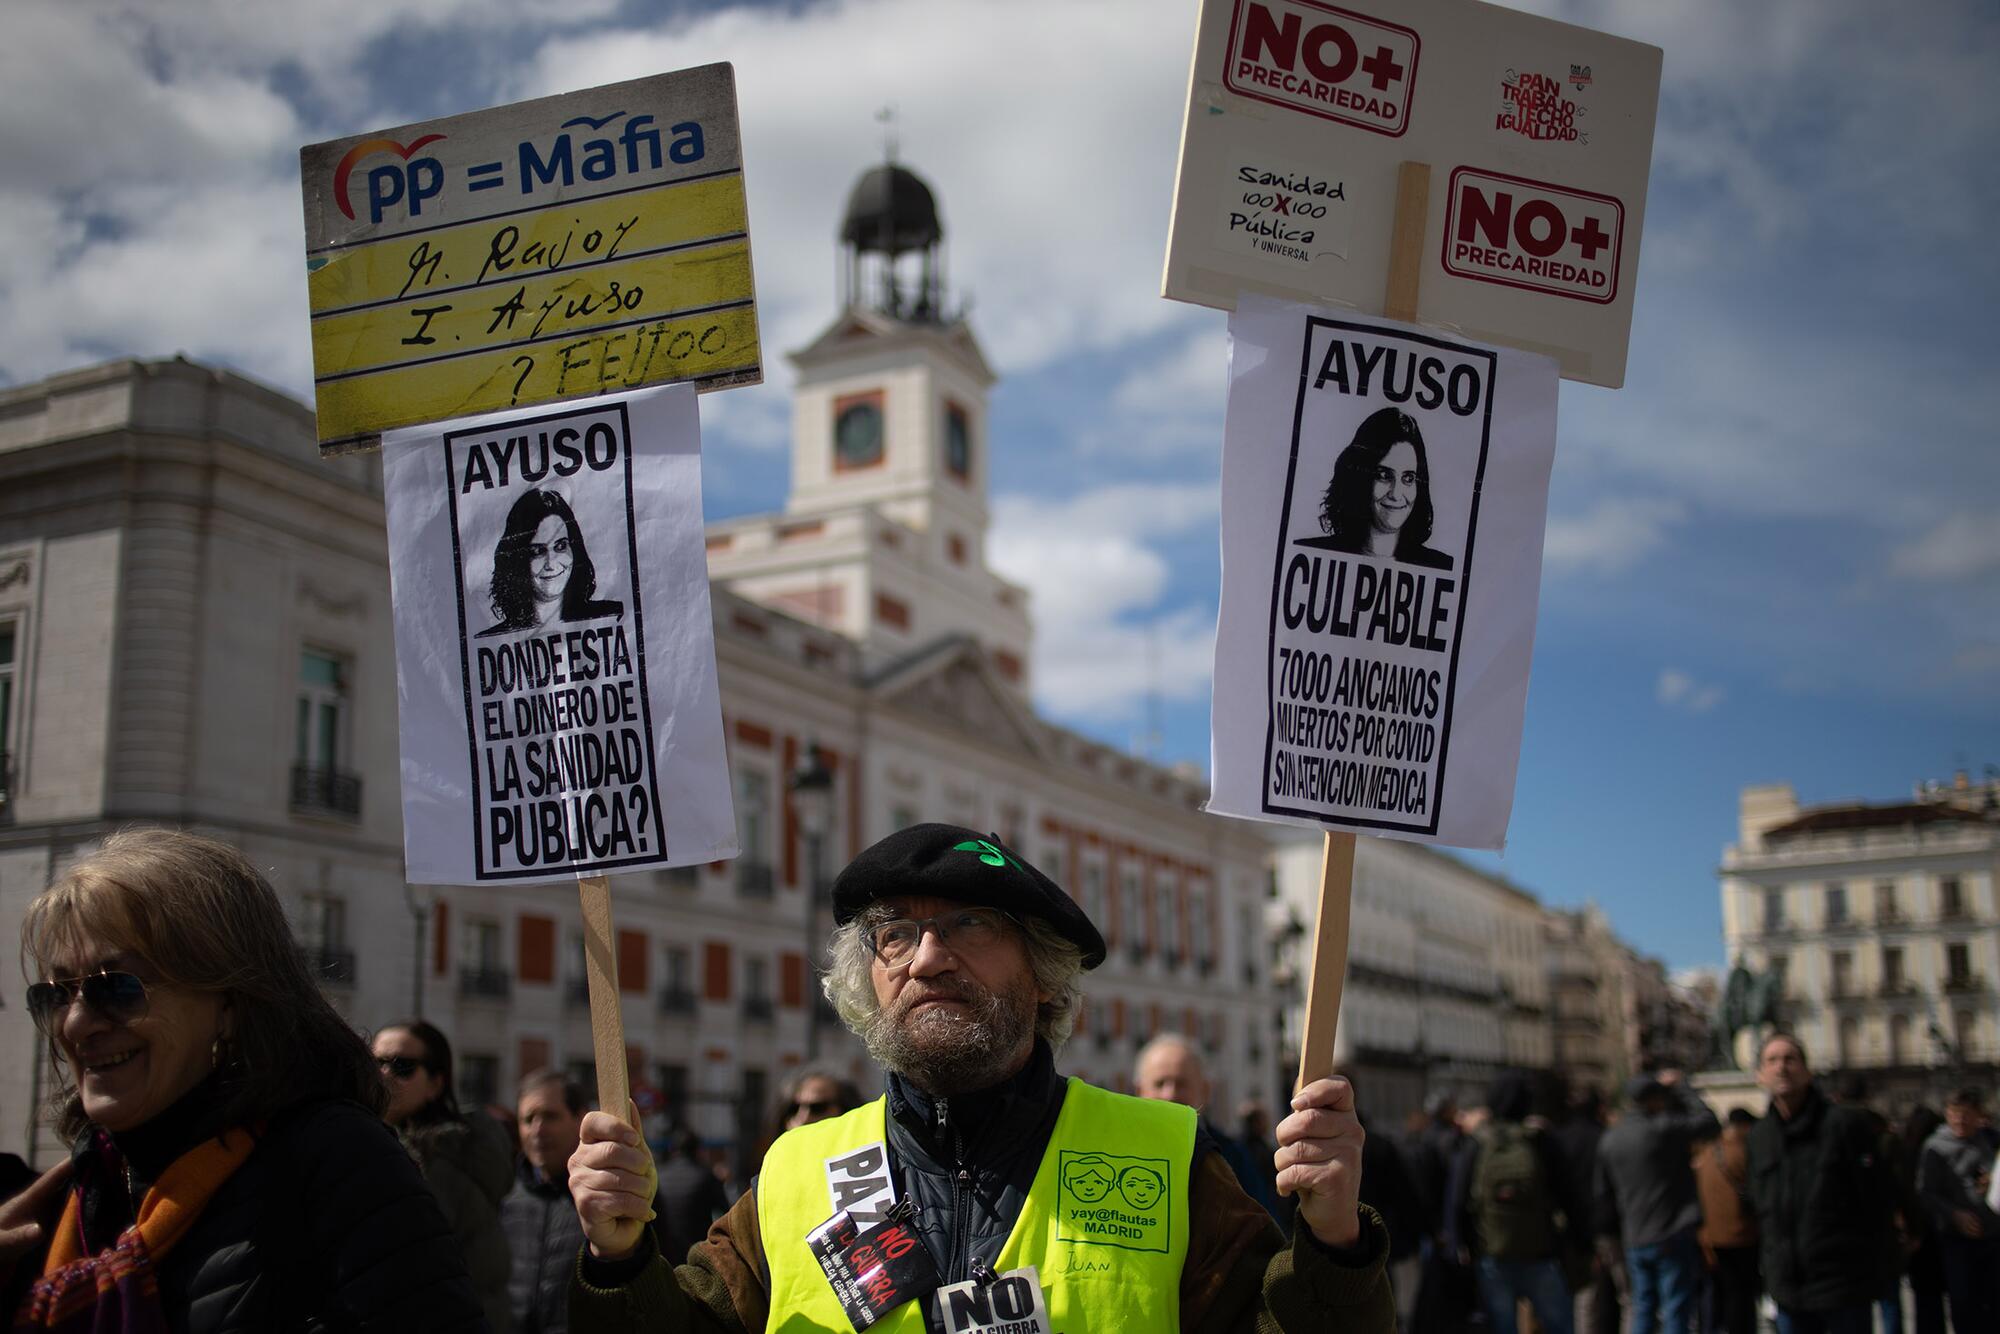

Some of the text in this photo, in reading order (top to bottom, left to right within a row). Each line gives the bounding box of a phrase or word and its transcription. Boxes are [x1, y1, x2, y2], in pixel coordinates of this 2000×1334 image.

[1238, 61, 1398, 120] PRECARIEDAD
[1501, 82, 1576, 115] TRABAJO
[1520, 73, 1561, 98] PAN
[1496, 113, 1578, 141] IGUALDAD
[1517, 101, 1574, 128] TECHO
[1238, 166, 1345, 201] Sanidad
[477, 216, 638, 284] Rajoy
[1230, 211, 1315, 243] Pública
[1252, 238, 1310, 261] Y UNIVERSAL
[1454, 243, 1607, 288] PRECARIEDAD
[487, 282, 644, 340] Ayuso
[512, 356, 534, 405] ?
[1313, 339, 1482, 417] AYUSO
[462, 421, 617, 494] AYUSO
[1281, 552, 1455, 653] CULPABLE
[477, 633, 566, 697] DONDE
[1279, 647, 1441, 719] 7000 ANCIANOS
[482, 680, 638, 742] EL DINERO DE
[1277, 701, 1436, 764] MUERTOS POR COVID
[487, 728, 643, 802] LA SANIDAD
[1273, 749, 1428, 815] SIN ATENCION MEDICA
[490, 784, 649, 868] PUBLICA?
[874, 1224, 916, 1259] NO
[1071, 1208, 1157, 1226] yay@flautas
[1084, 1222, 1143, 1240] MADRID
[833, 1279, 853, 1307] GENERAL
[948, 1276, 1035, 1332] NO
